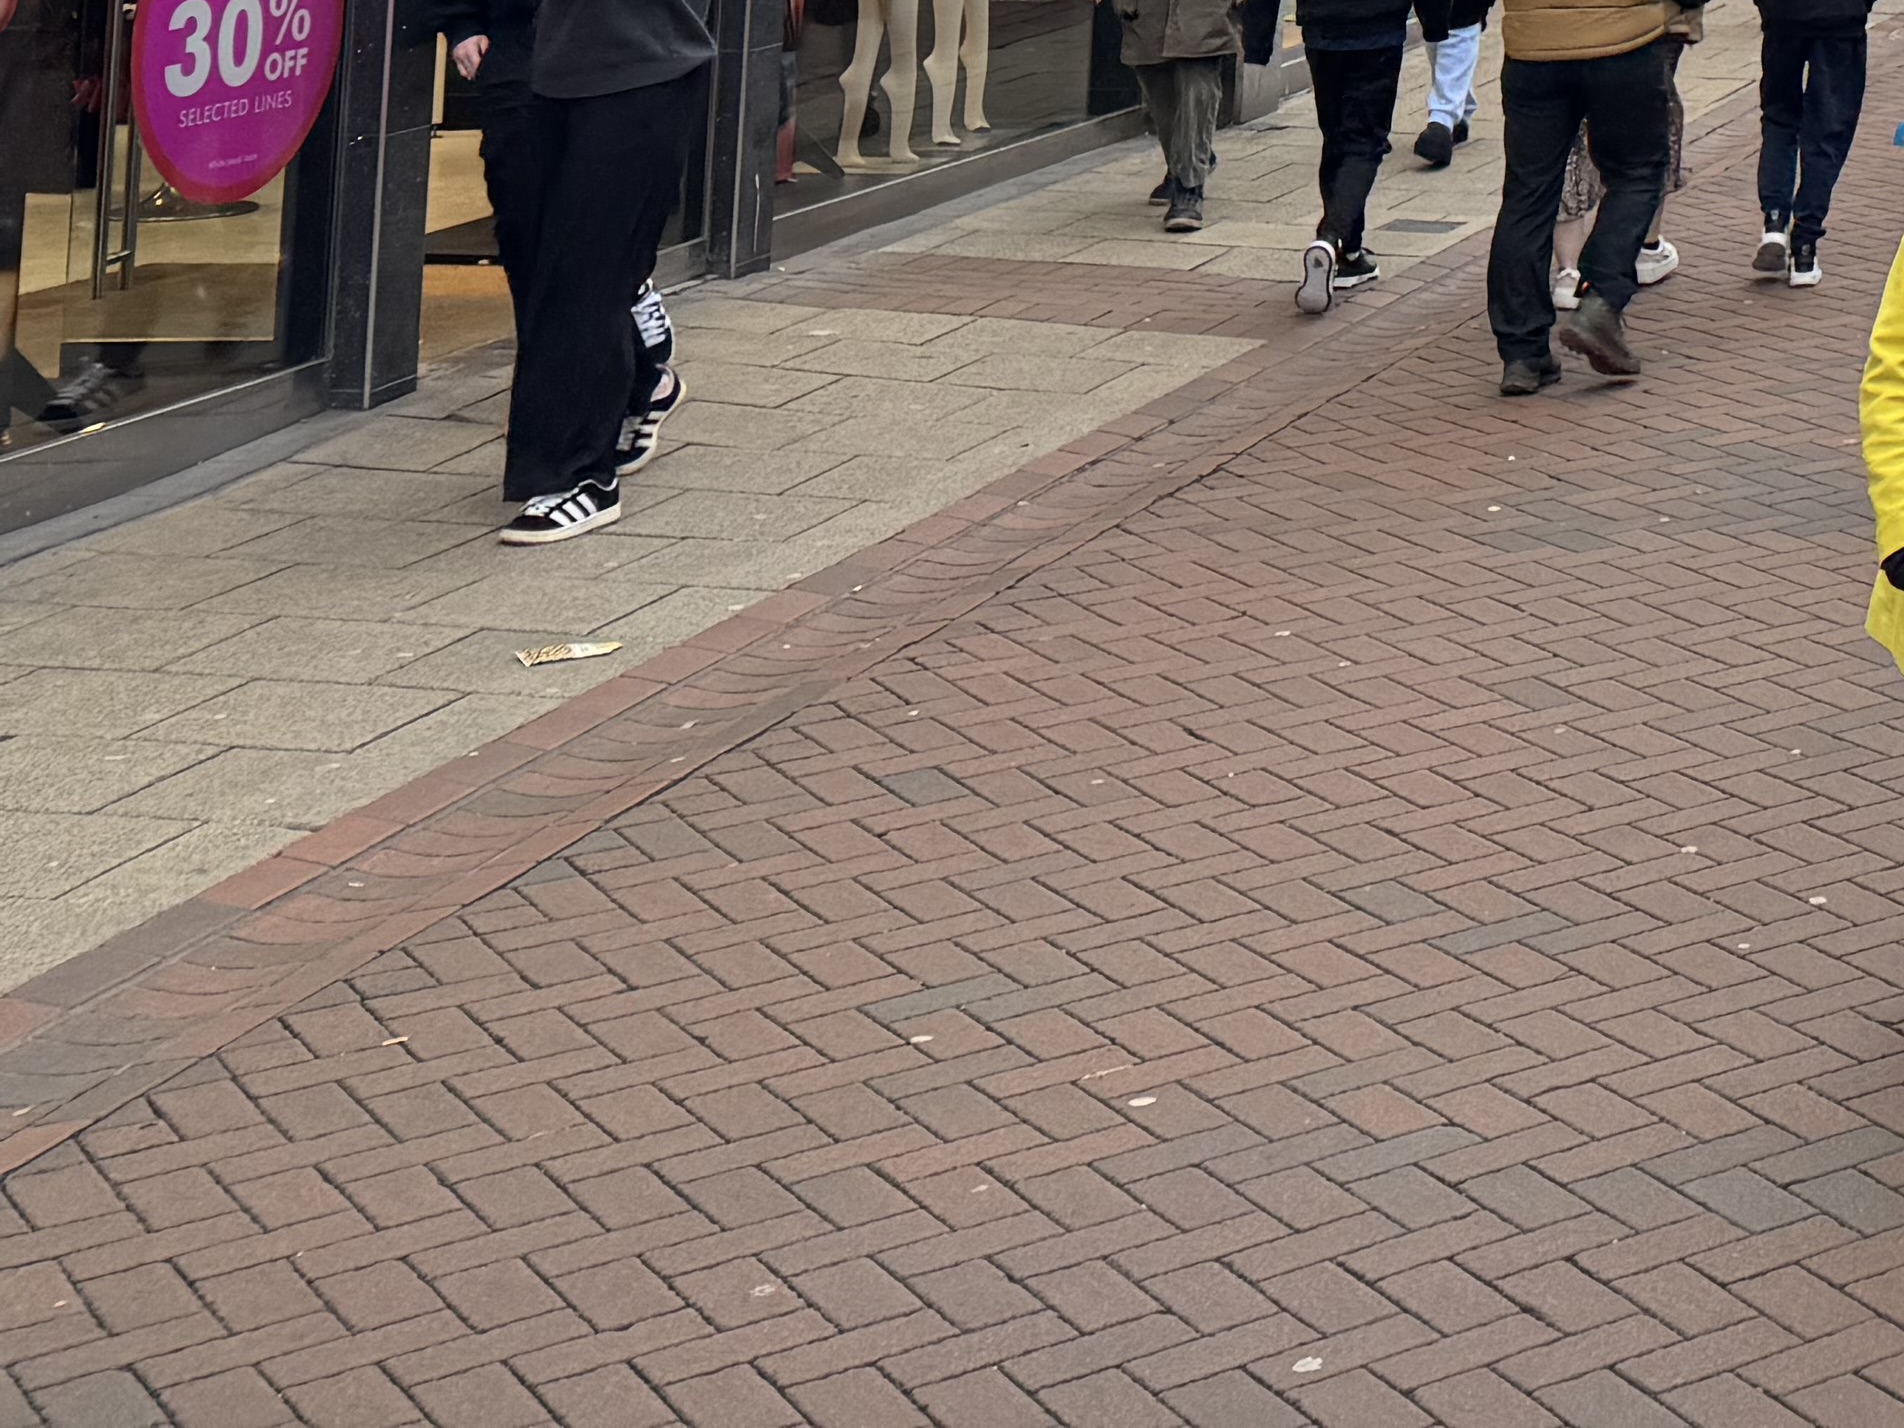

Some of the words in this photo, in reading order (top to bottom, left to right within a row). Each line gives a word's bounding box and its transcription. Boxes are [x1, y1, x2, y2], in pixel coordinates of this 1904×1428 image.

[263, 47, 310, 82] OFF
[178, 96, 249, 128] SELECTED
[254, 89, 293, 114] LINES
